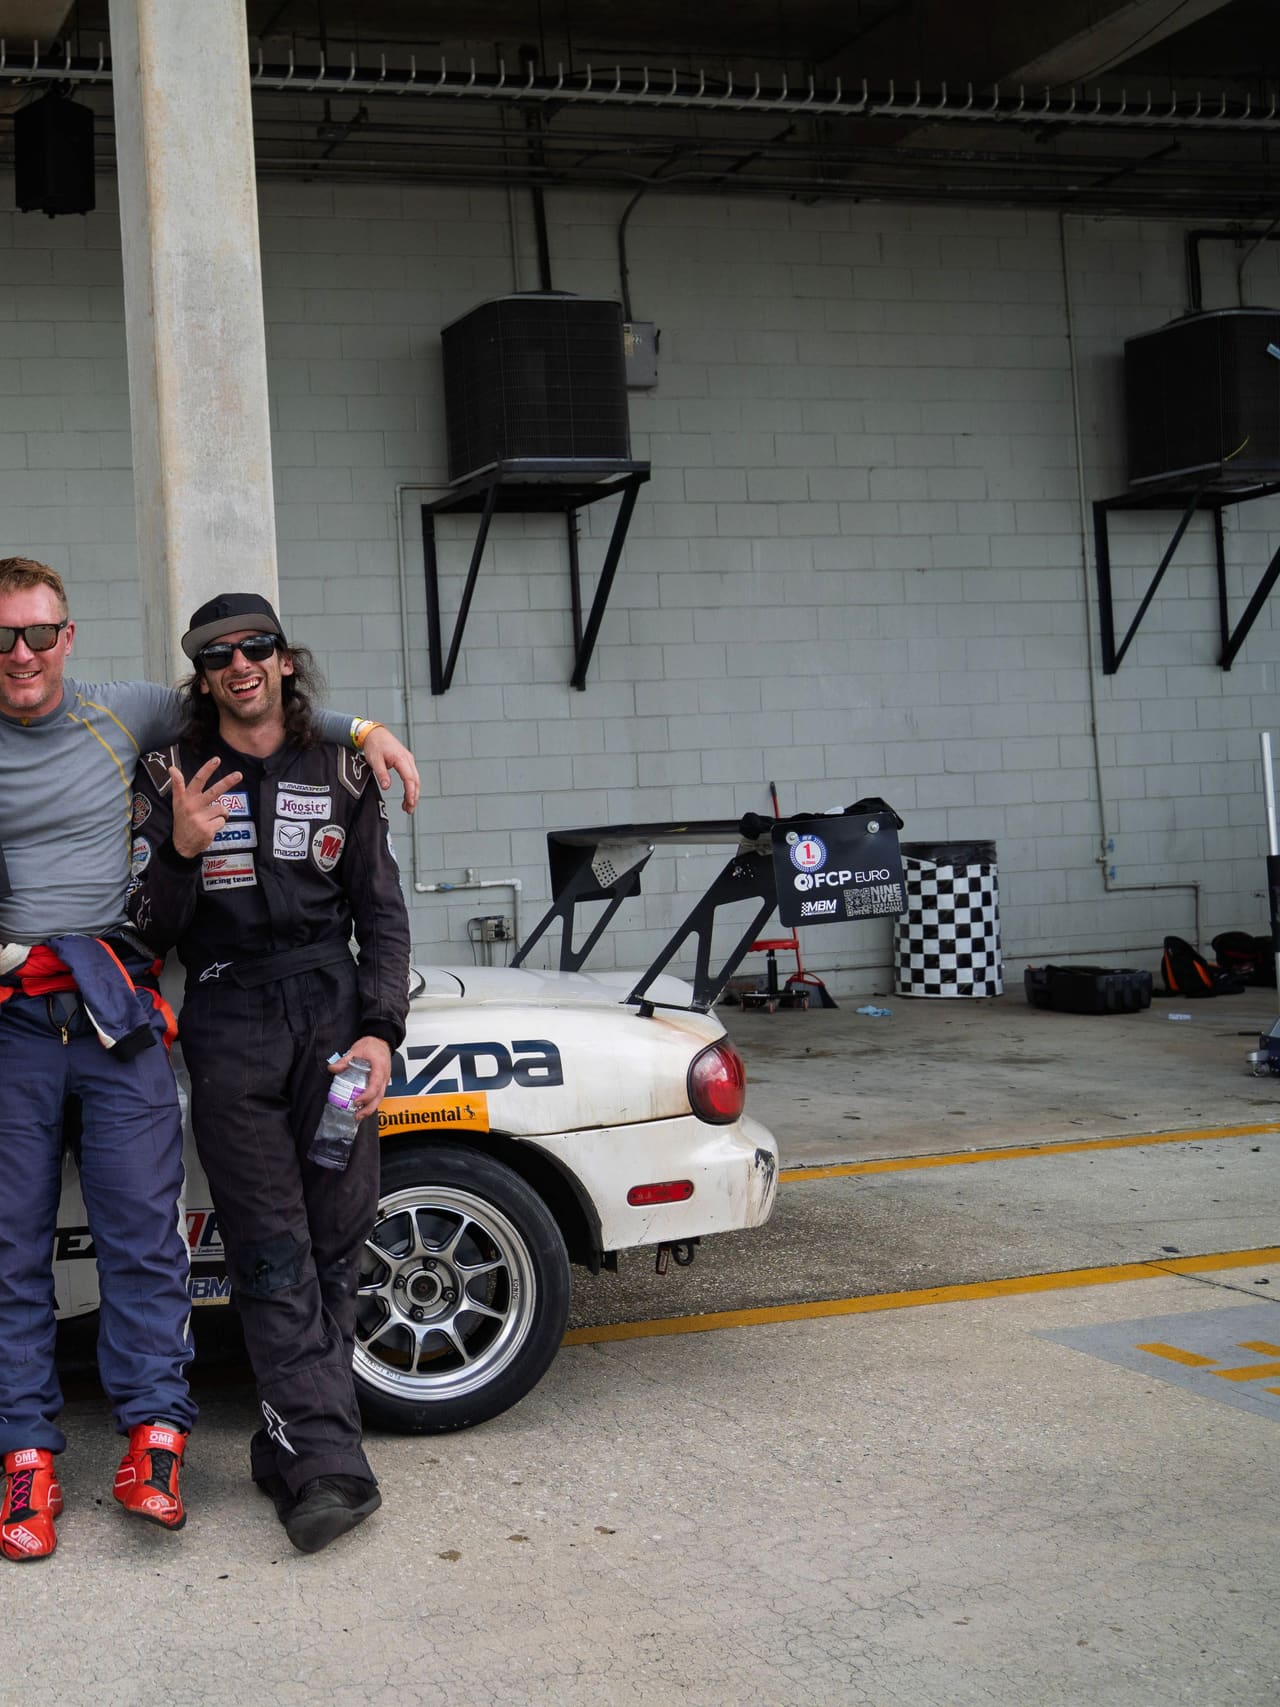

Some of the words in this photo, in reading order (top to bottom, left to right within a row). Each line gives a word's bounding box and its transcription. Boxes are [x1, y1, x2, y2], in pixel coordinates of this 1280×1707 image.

[280, 799, 328, 812] Hoosier
[206, 877, 232, 886] racing
[814, 870, 852, 888] FCP
[855, 869, 890, 883] EURO
[871, 883, 901, 896] NINE
[872, 894, 902, 904] LIVES
[807, 899, 838, 913] MBM
[873, 905, 904, 915] RACING
[150, 1432, 174, 1445] OMP
[14, 1450, 39, 1463] OMP
